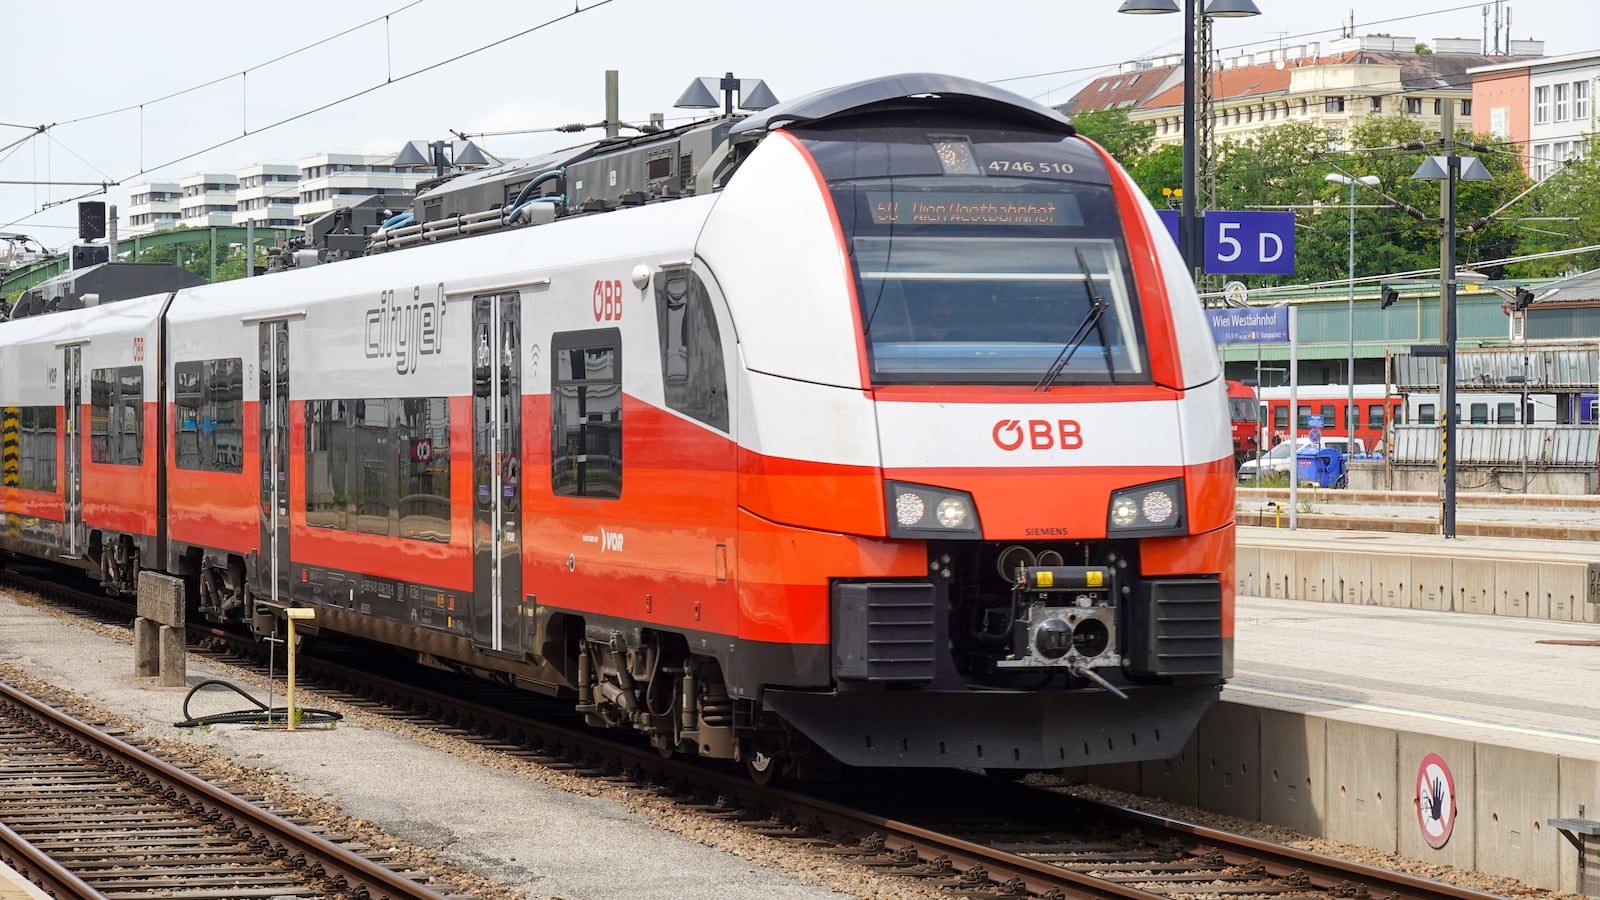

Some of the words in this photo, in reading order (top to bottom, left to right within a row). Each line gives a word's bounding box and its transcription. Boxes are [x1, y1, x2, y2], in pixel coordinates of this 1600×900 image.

[988, 160, 1034, 173] 4746
[1039, 162, 1074, 175] 510
[1217, 222, 1242, 262] 5
[1259, 232, 1283, 263] D
[593, 279, 623, 322] ÖBB
[364, 282, 447, 376] cityjet
[1212, 315, 1230, 327] Wien
[1231, 313, 1277, 327] Westbahnhof
[991, 418, 1084, 451] ÖBB
[1024, 527, 1069, 537] SIEMENS
